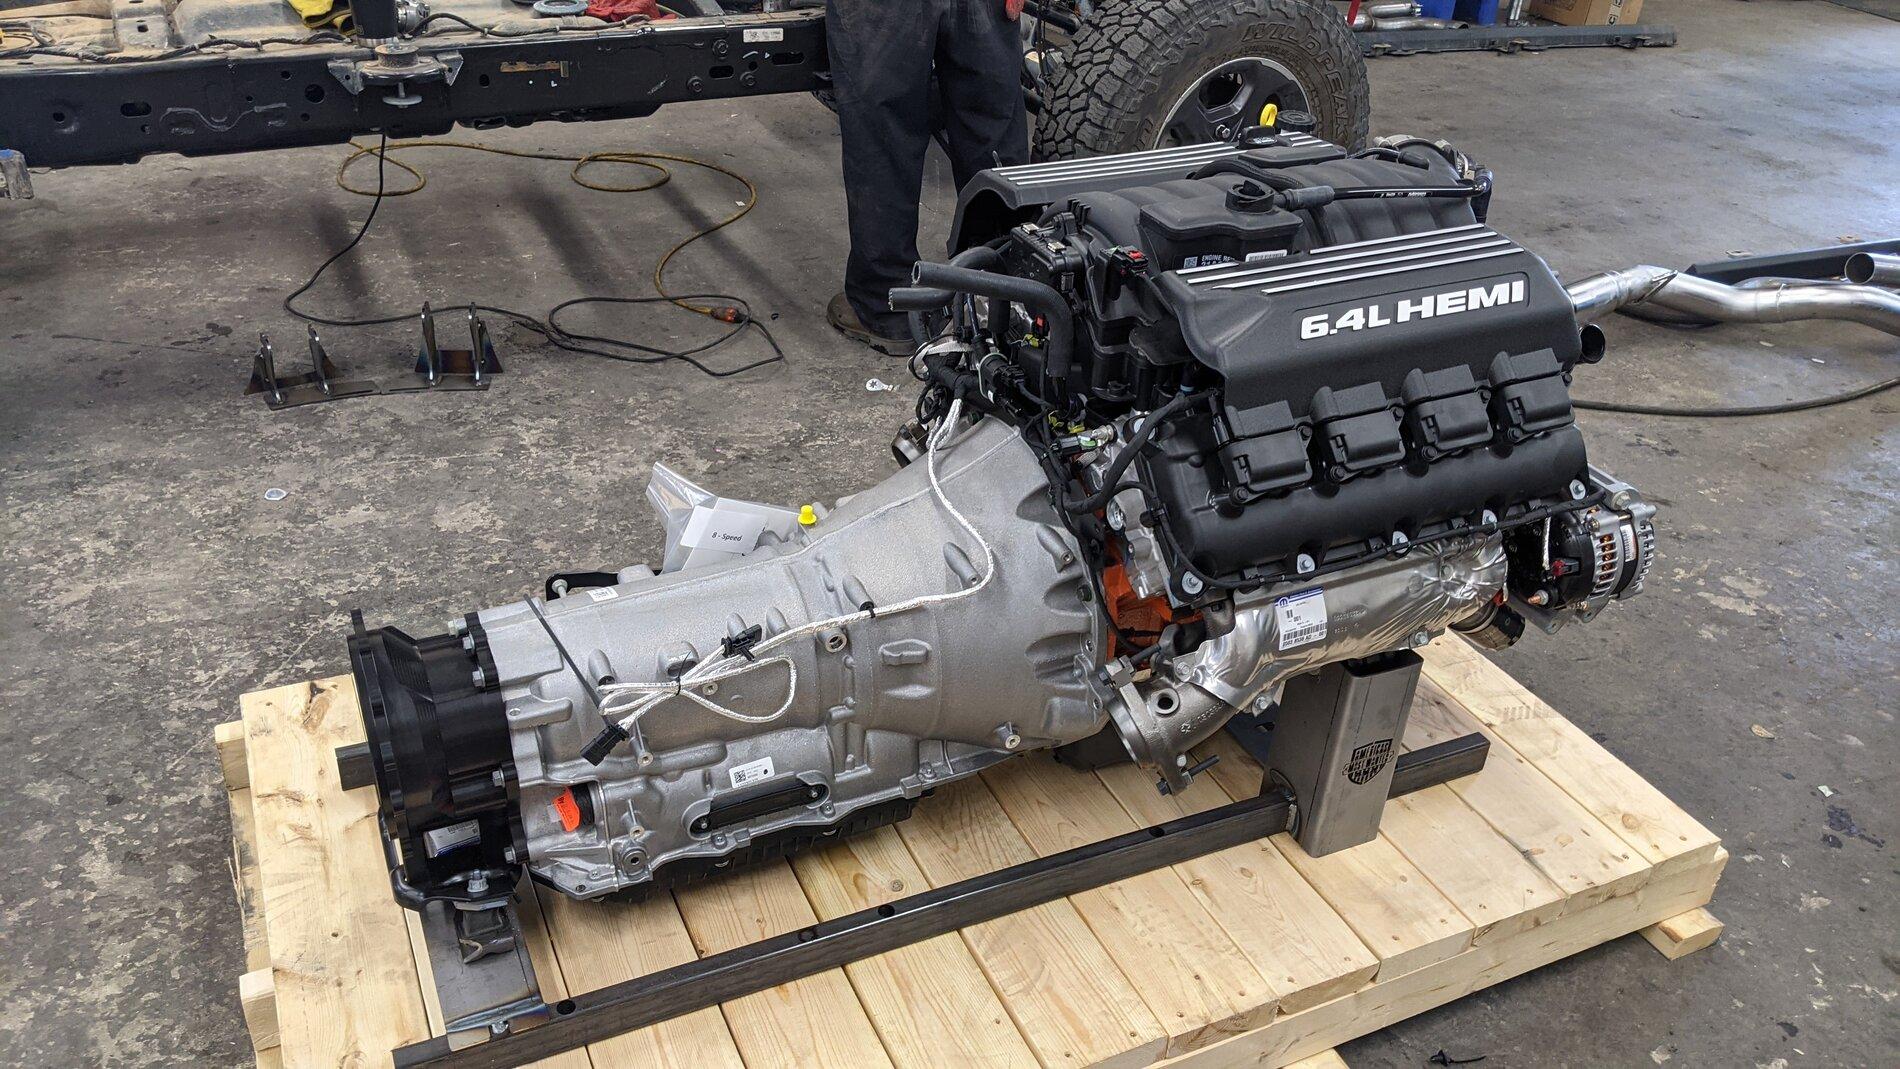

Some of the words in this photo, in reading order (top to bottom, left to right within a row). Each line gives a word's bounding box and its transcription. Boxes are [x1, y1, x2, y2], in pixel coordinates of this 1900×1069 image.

[1242, 22, 1350, 139] WILDPEAK
[1300, 304, 1391, 340] 6.4L
[1396, 280, 1525, 323] HEMI
[711, 531, 718, 539] 8
[721, 533, 743, 541] Speed
